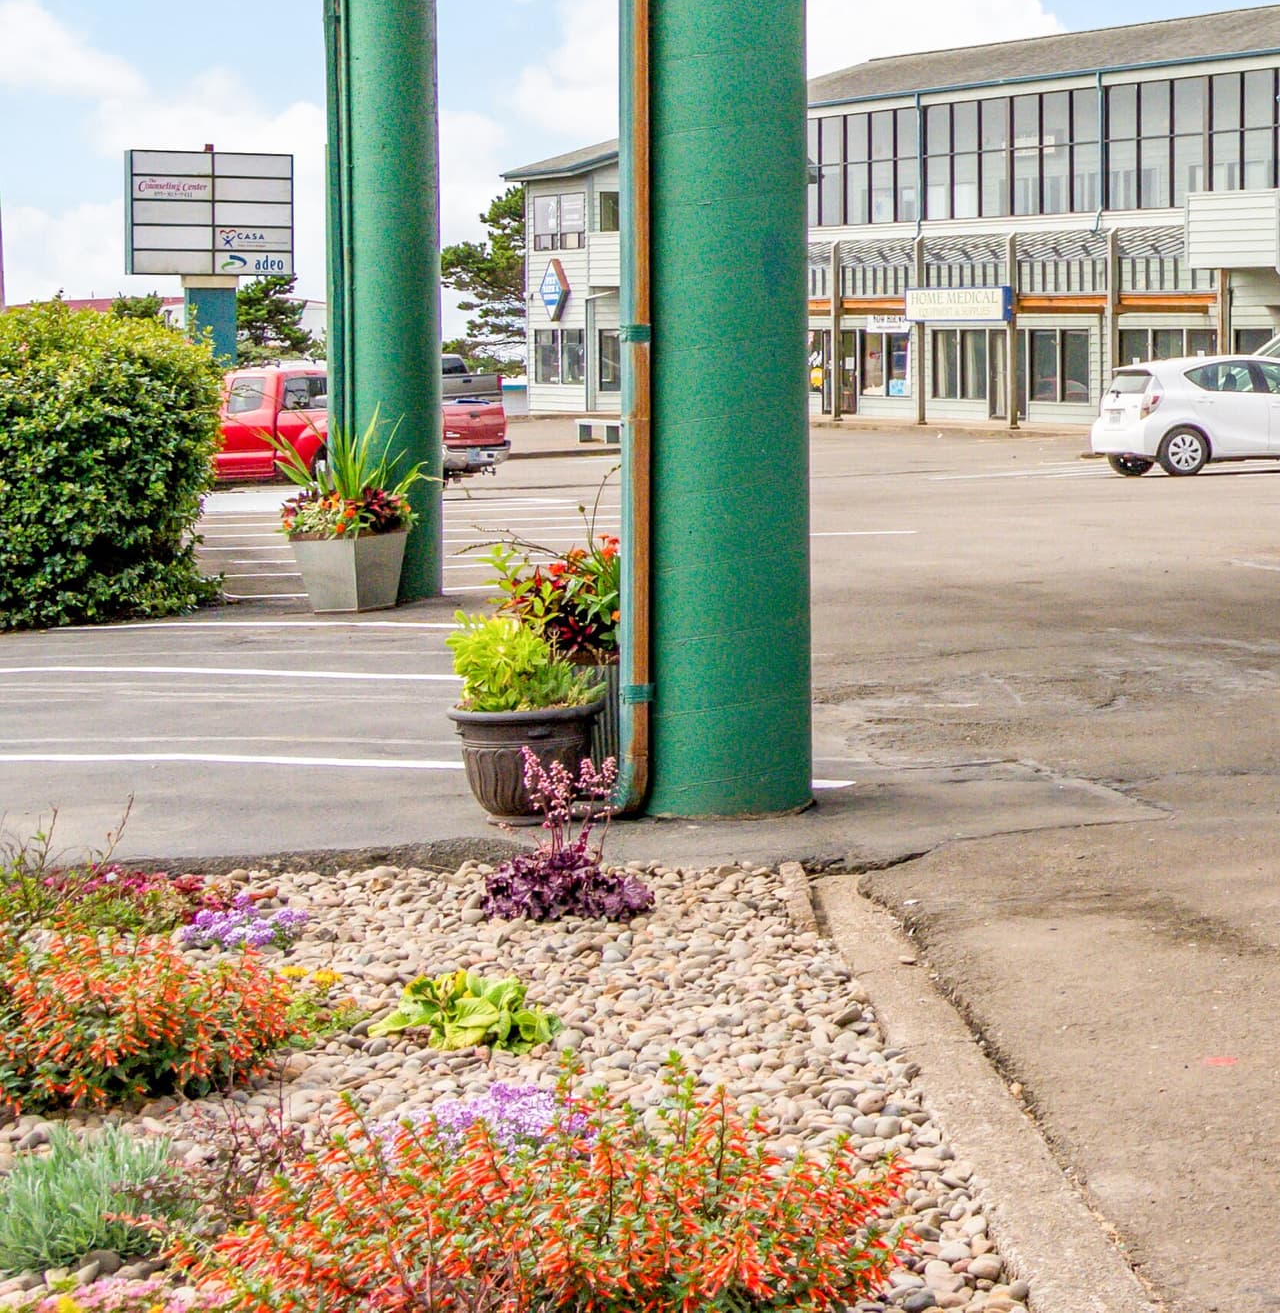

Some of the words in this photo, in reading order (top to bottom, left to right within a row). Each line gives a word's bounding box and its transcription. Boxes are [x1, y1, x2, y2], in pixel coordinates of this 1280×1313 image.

[182, 183, 208, 191] Center
[255, 255, 284, 271] adeo
[911, 292, 943, 305] HOME
[947, 291, 999, 304] MEDICAL
